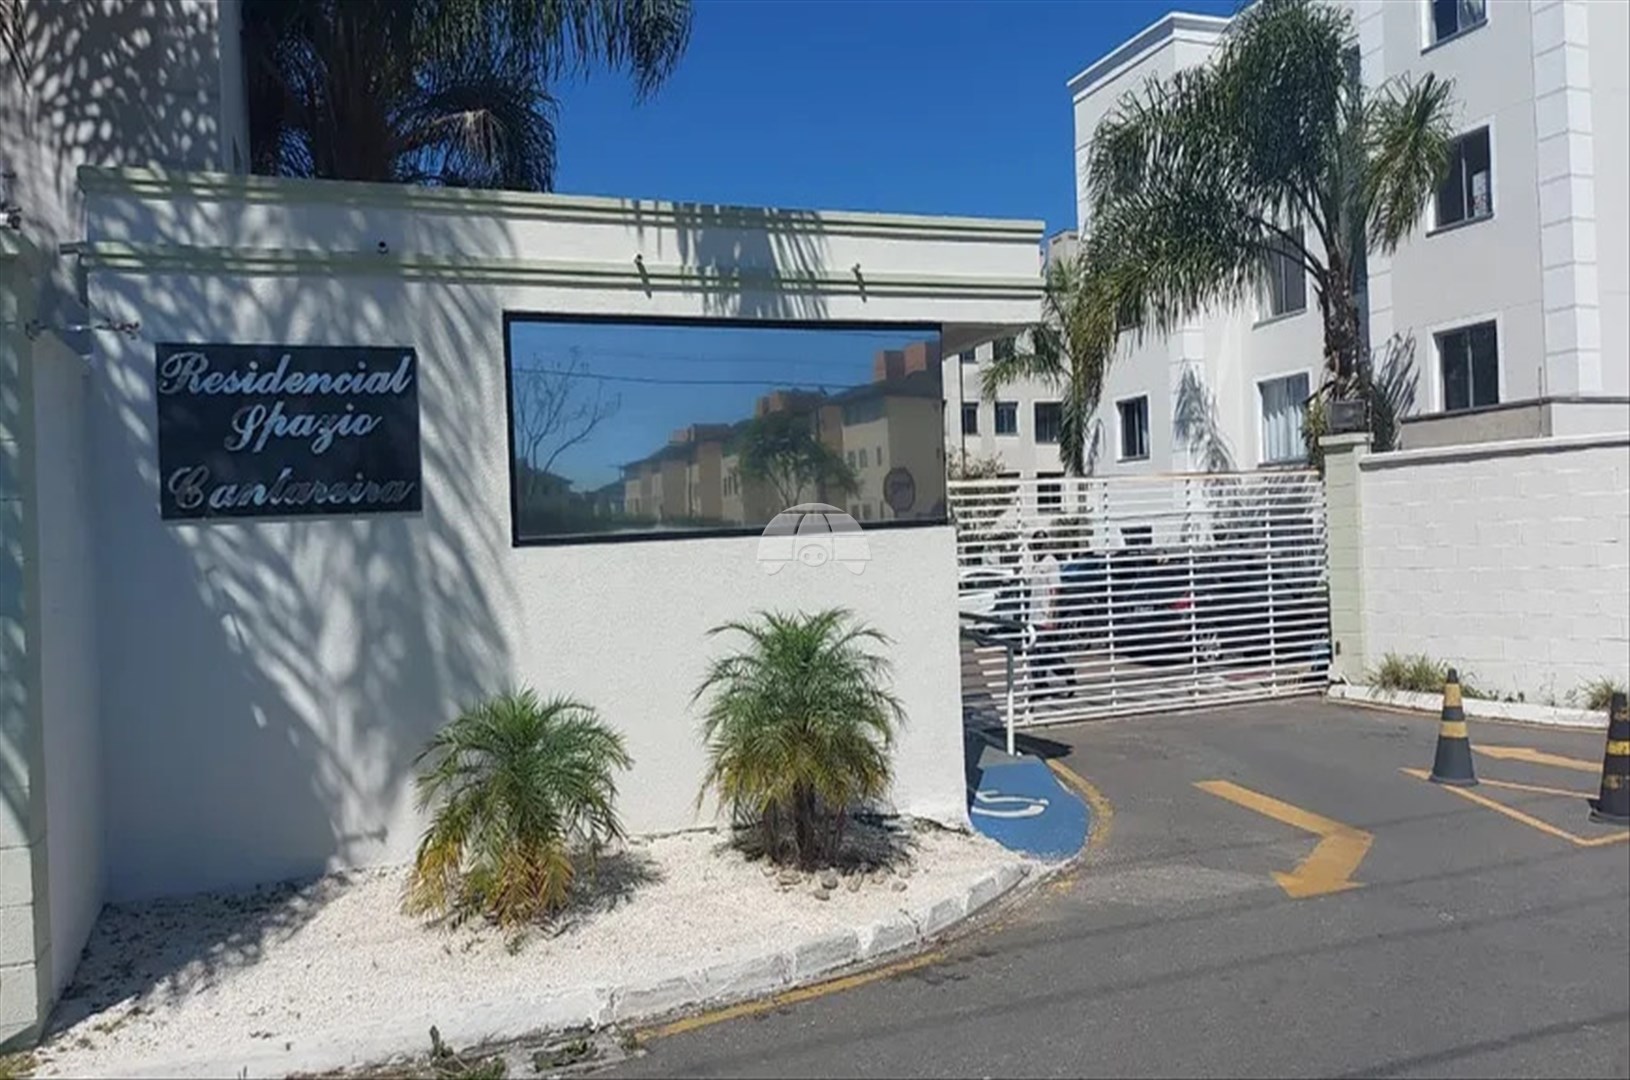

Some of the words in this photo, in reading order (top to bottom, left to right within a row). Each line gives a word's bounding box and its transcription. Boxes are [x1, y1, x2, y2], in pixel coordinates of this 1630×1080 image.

[159, 352, 412, 394] Residencial
[224, 401, 382, 453] Spazio
[168, 465, 415, 509] Cantareira
